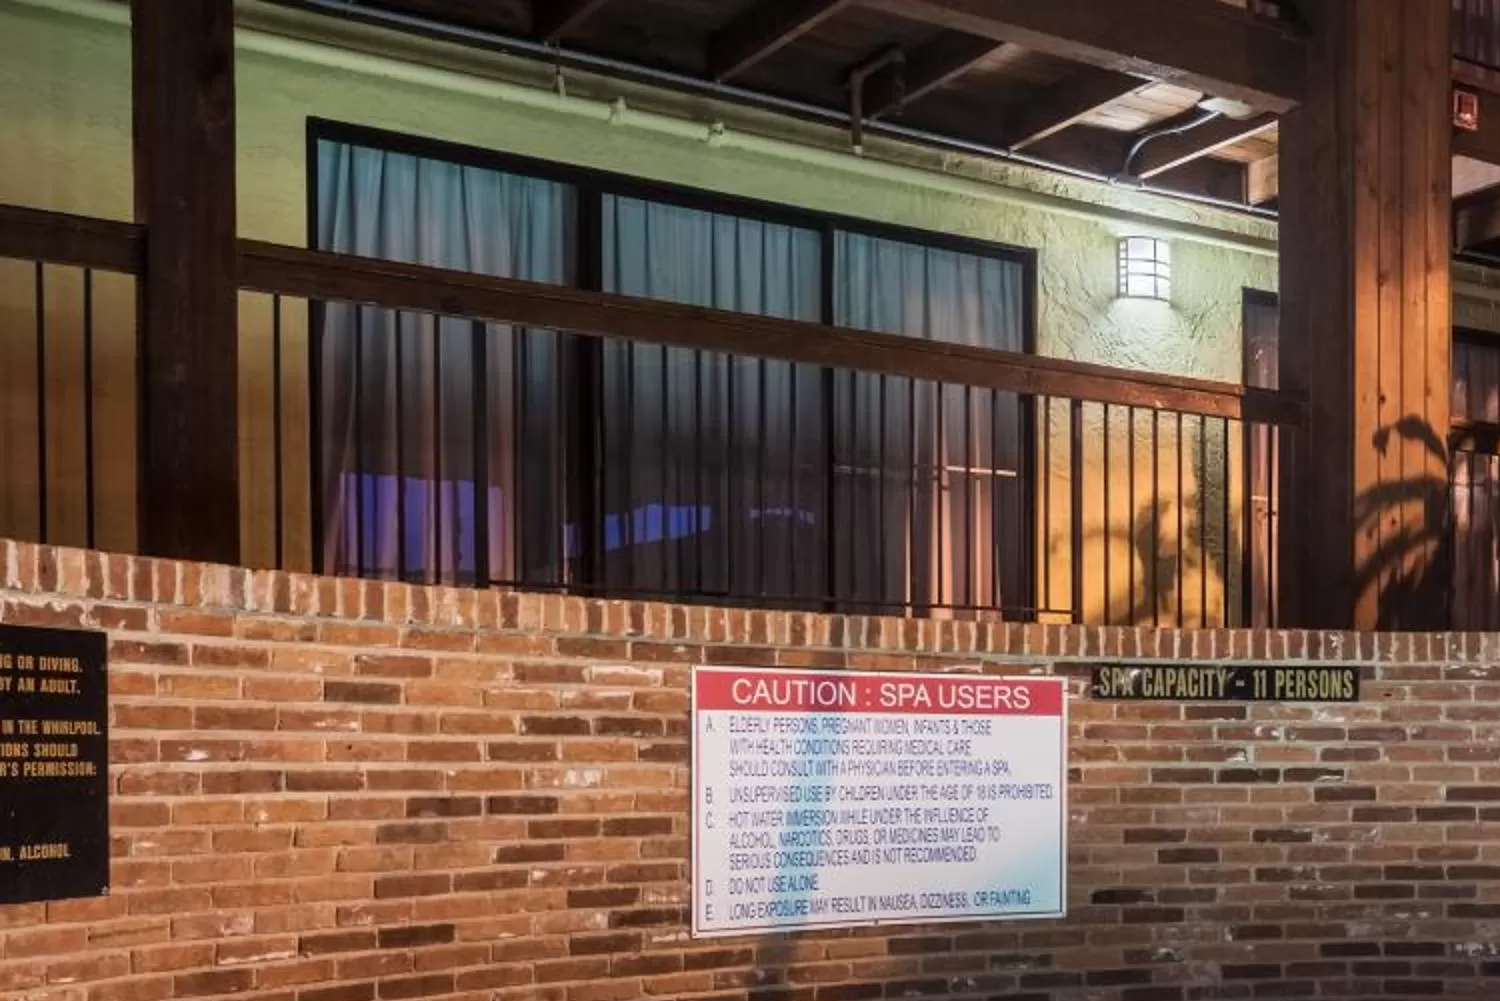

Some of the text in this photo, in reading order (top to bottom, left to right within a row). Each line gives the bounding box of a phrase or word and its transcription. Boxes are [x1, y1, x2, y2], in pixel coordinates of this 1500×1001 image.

[17, 655, 34, 670] OR
[18, 677, 35, 692] AN
[1100, 667, 1137, 697] SPA
[1141, 667, 1228, 698] CAPACITY
[1253, 669, 1268, 698] 11
[1275, 669, 1353, 699] PERSONS
[731, 678, 856, 706] CAUTION
[880, 682, 932, 707] SPA
[938, 685, 1031, 709] USERS
[17, 720, 39, 735] THE
[730, 715, 770, 733] ELDERLY
[822, 717, 870, 735] PREGNANT
[961, 719, 992, 736] THOSE
[33, 743, 78, 758] SHOULD
[756, 738, 793, 755] HEALTH
[794, 739, 850, 755] CONDITIONS
[852, 739, 903, 755] REQUIRING
[905, 739, 944, 755] MEDICAL
[729, 759, 767, 777] SHOULD
[772, 759, 813, 777] CONSULT
[815, 759, 839, 776] WITH
[840, 759, 847, 776] A
[848, 759, 895, 776] PHYSICIAN
[897, 759, 935, 776] BEFORE
[938, 759, 982, 776] ENTERING
[730, 785, 803, 802] UNSUPERVISED
[804, 785, 823, 801] USE
[825, 785, 837, 801] BY
[839, 784, 885, 801] CHILDREN
[887, 784, 918, 800] UNDER
[920, 784, 938, 800] THE
[939, 784, 959, 800] AGE
[961, 784, 973, 800] OF
[987, 783, 997, 800] IS
[730, 811, 750, 828] HOT
[751, 811, 784, 827] WATER
[786, 809, 838, 827] IMMERSION
[869, 807, 901, 825] UNDER
[903, 807, 921, 824] THE
[923, 807, 975, 823] INFLUENCE
[977, 807, 989, 823] OF
[873, 827, 887, 845] OR
[889, 827, 939, 845] MEDICINES
[940, 827, 960, 844] MAY
[961, 826, 985, 843] LEAD
[987, 826, 1001, 843] TO
[729, 852, 771, 871] SERIOUS
[773, 849, 849, 869] CONSEQUENCES
[851, 848, 871, 865] AND
[883, 848, 901, 865] NOT
[729, 877, 744, 895] DO
[745, 876, 766, 894] NOT
[767, 875, 787, 893] USE
[729, 902, 756, 921] LONG
[757, 899, 810, 919] EXPOSURE
[831, 896, 867, 913] RESULT
[974, 890, 988, 907] OR
